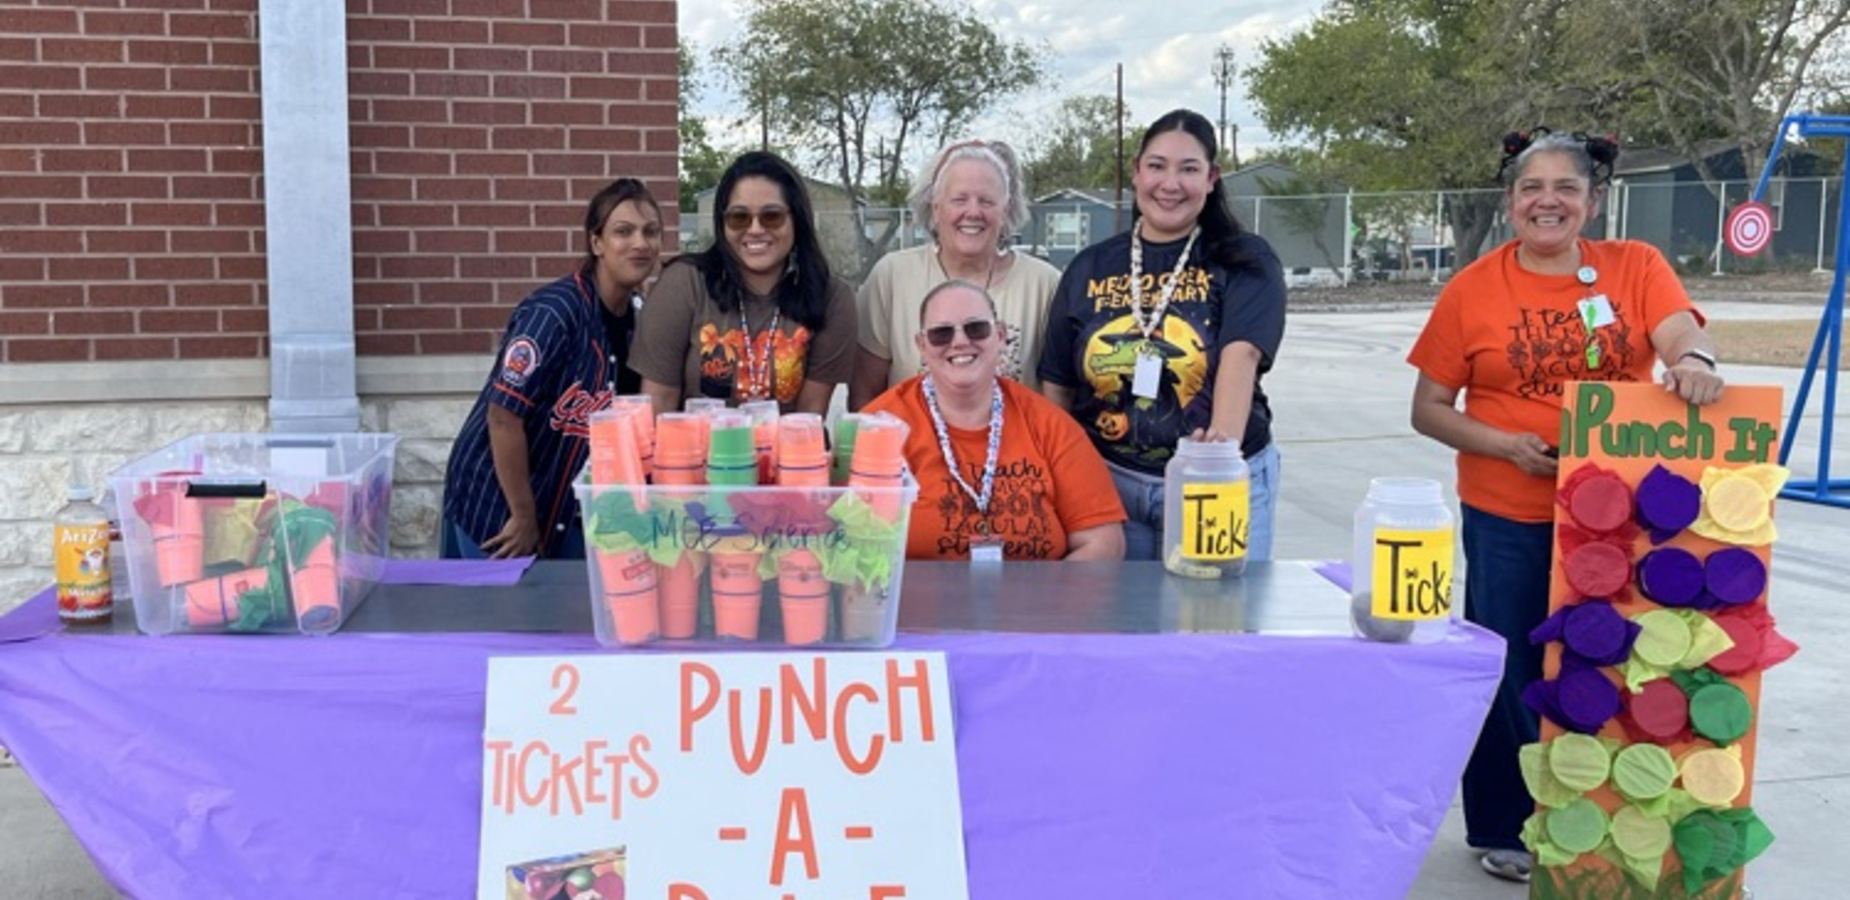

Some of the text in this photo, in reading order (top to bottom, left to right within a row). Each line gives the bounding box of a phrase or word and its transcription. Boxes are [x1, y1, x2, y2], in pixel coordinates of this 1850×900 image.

[1574, 382, 1715, 460] Punch
[1724, 417, 1777, 464] It
[966, 457, 1042, 480] tach
[548, 662, 580, 715] 2
[679, 656, 936, 776] PUNCH
[486, 733, 659, 821] TICKETS
